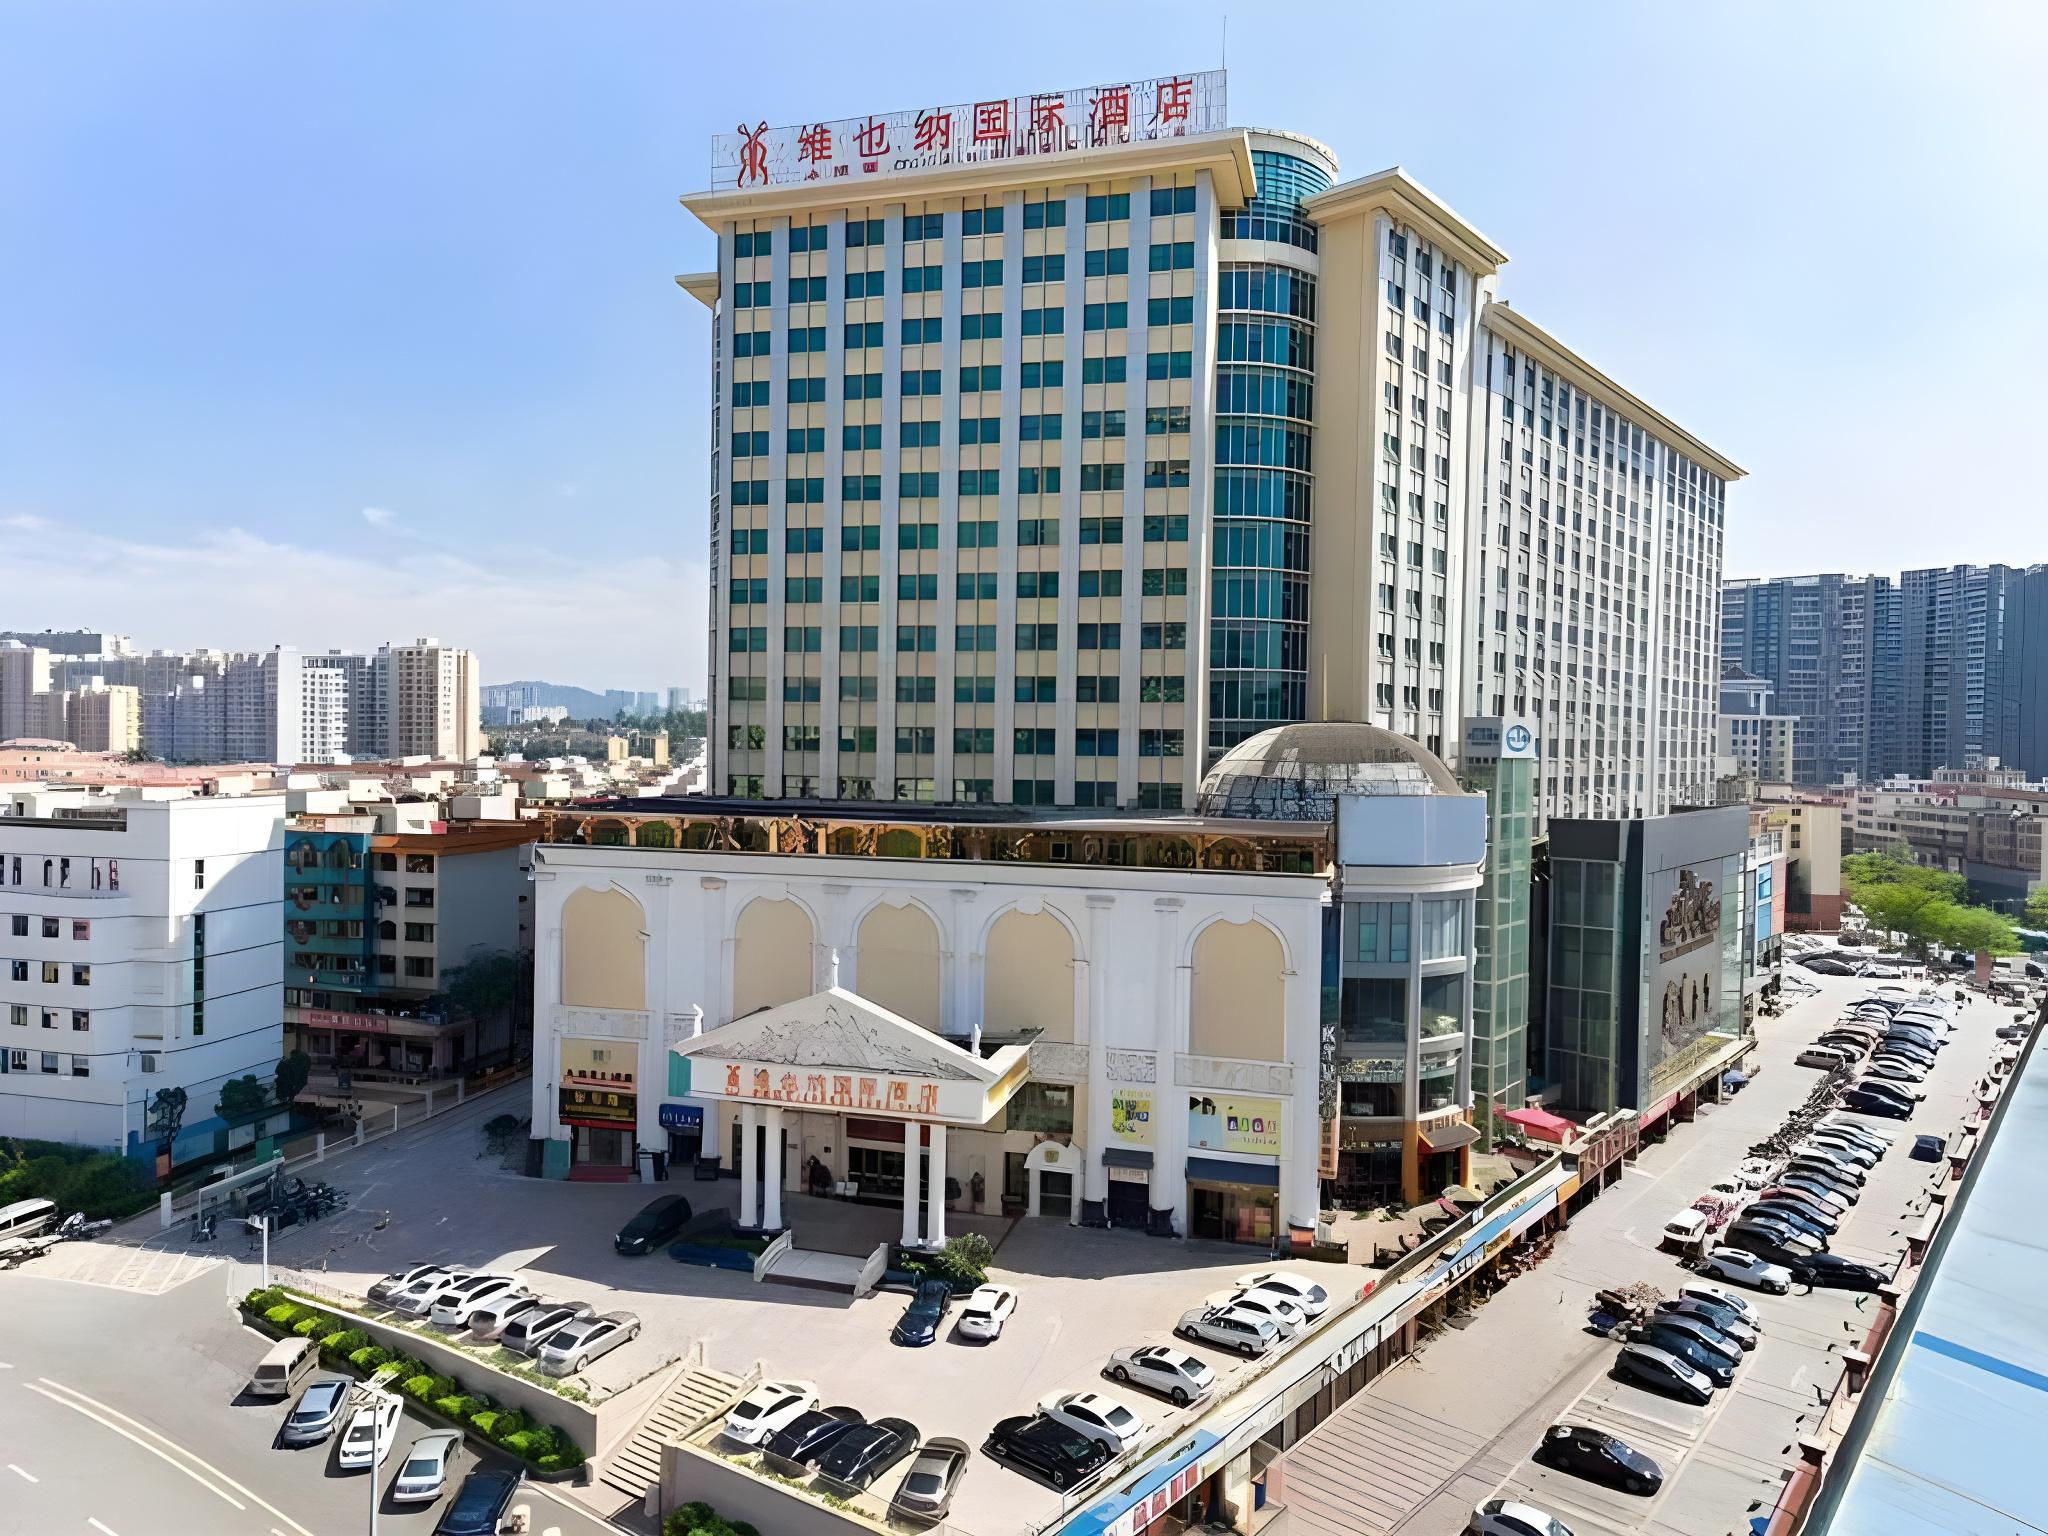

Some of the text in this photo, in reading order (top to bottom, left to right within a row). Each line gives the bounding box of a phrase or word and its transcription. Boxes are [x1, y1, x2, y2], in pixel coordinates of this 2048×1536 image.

[798, 75, 1193, 165] 维也纳国际酒店
